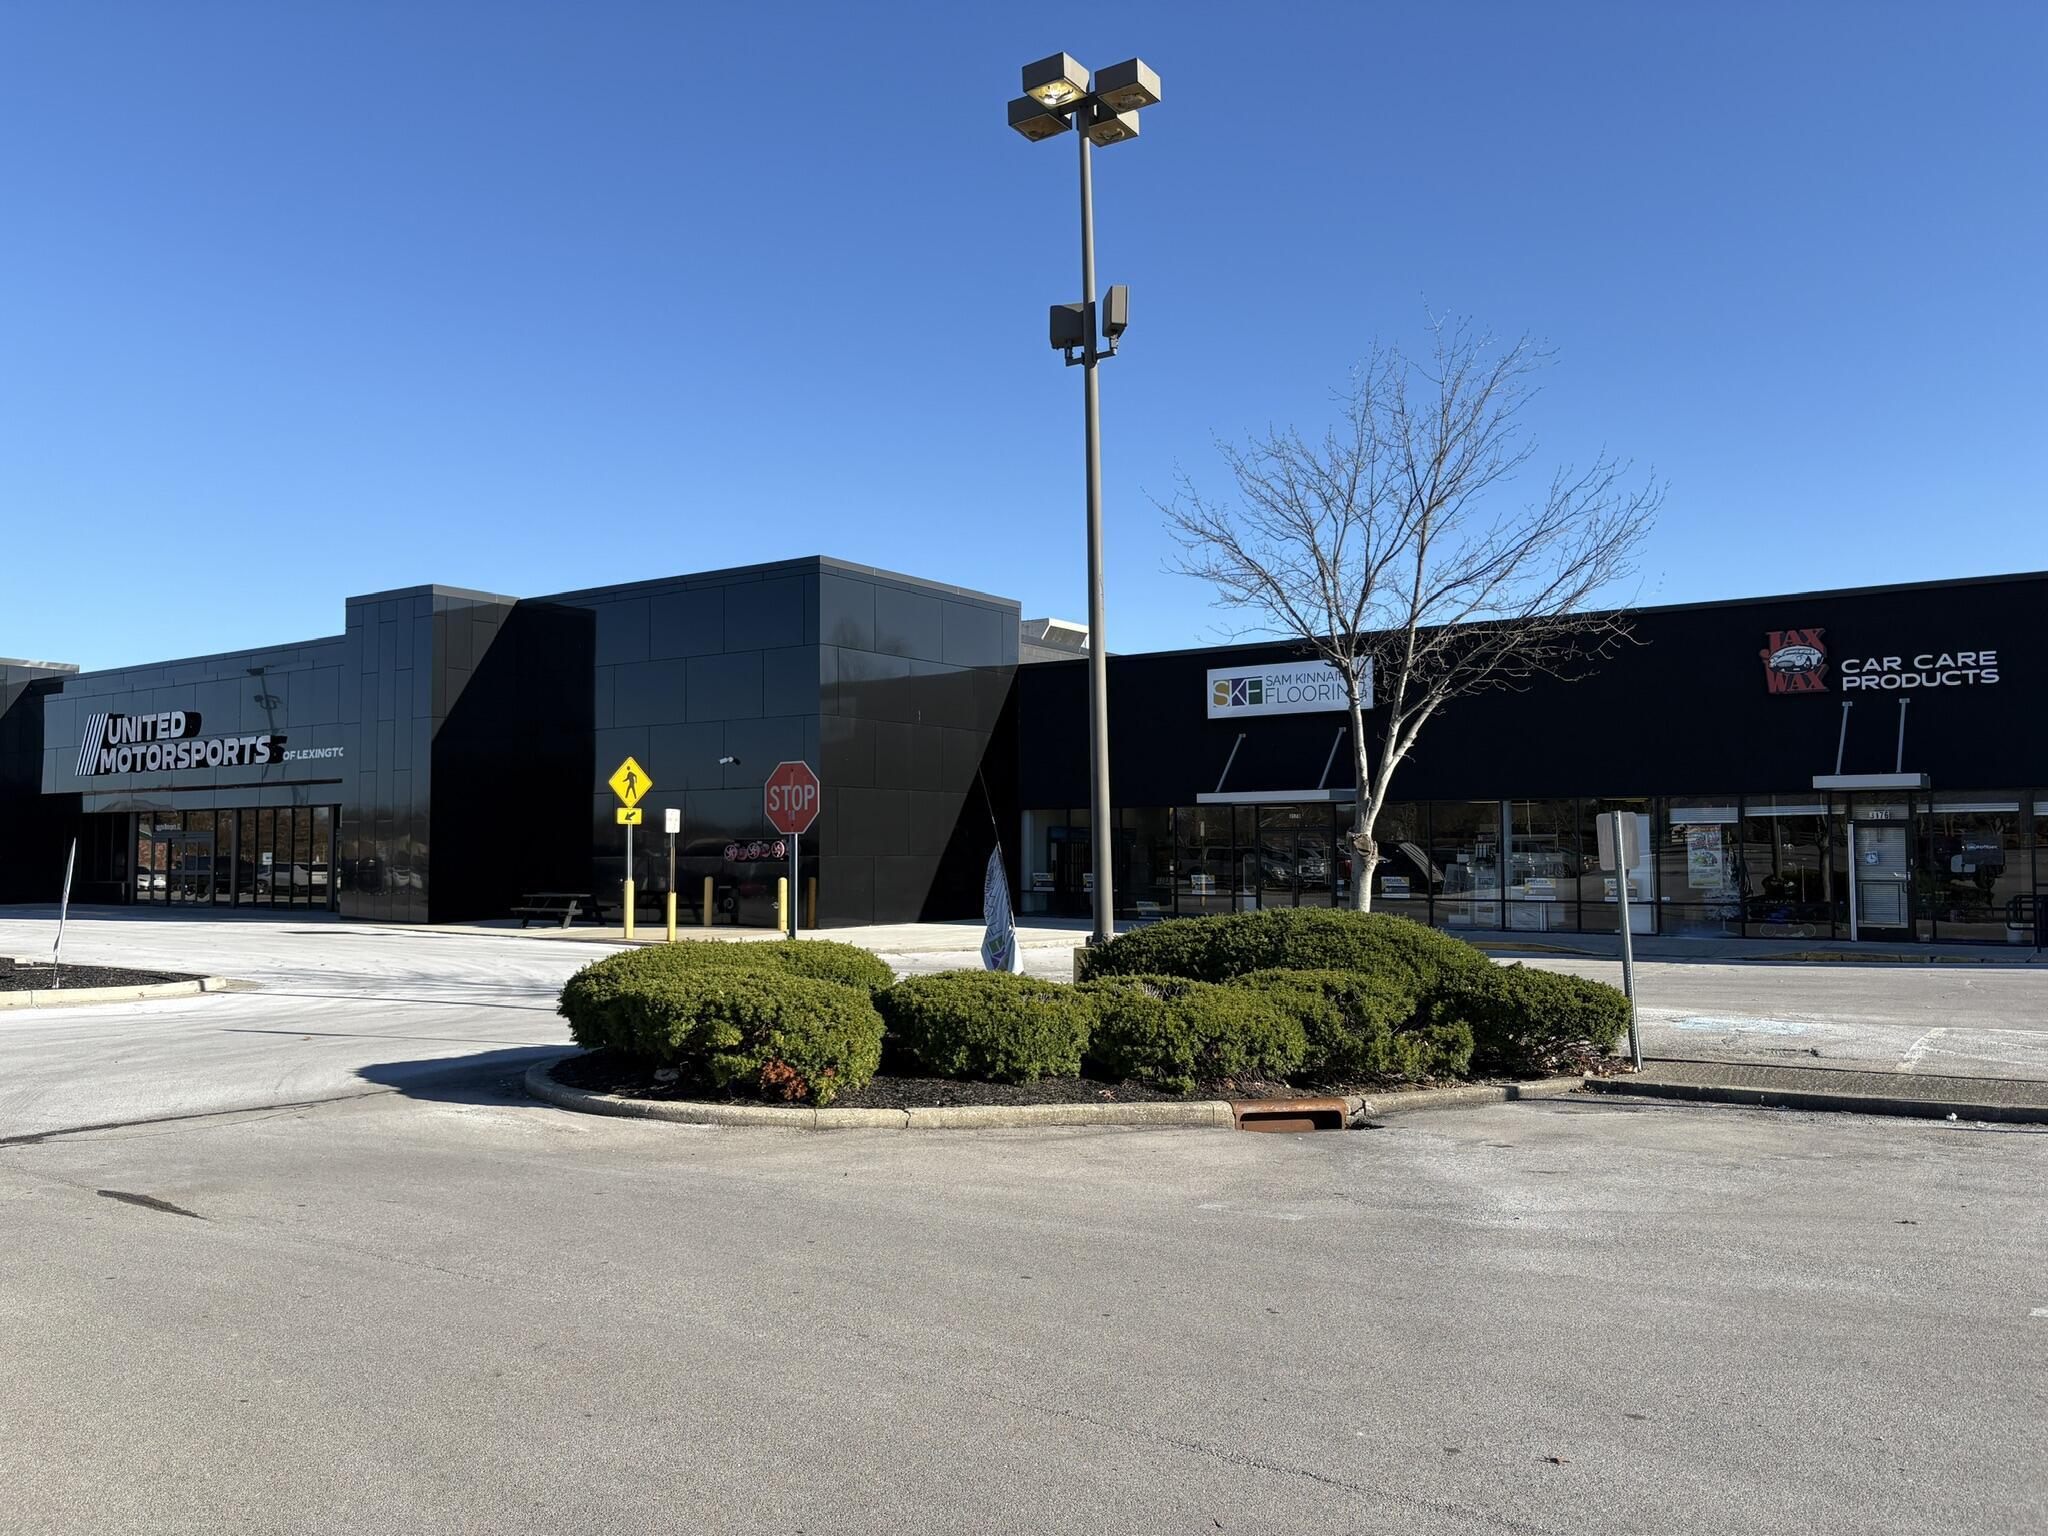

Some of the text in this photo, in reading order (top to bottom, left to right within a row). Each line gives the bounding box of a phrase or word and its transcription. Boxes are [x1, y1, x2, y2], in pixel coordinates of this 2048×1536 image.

[1760, 628, 1826, 660] JAX
[1841, 650, 1998, 674] CAR CARE
[1265, 673, 1292, 687] SAM
[1763, 661, 1829, 694] WAX
[1842, 668, 2000, 691] PRODUCTS
[107, 711, 186, 745] UNITED
[99, 735, 271, 774] MOTORSPORTS
[282, 750, 296, 761] OF
[769, 784, 815, 812] STOP
